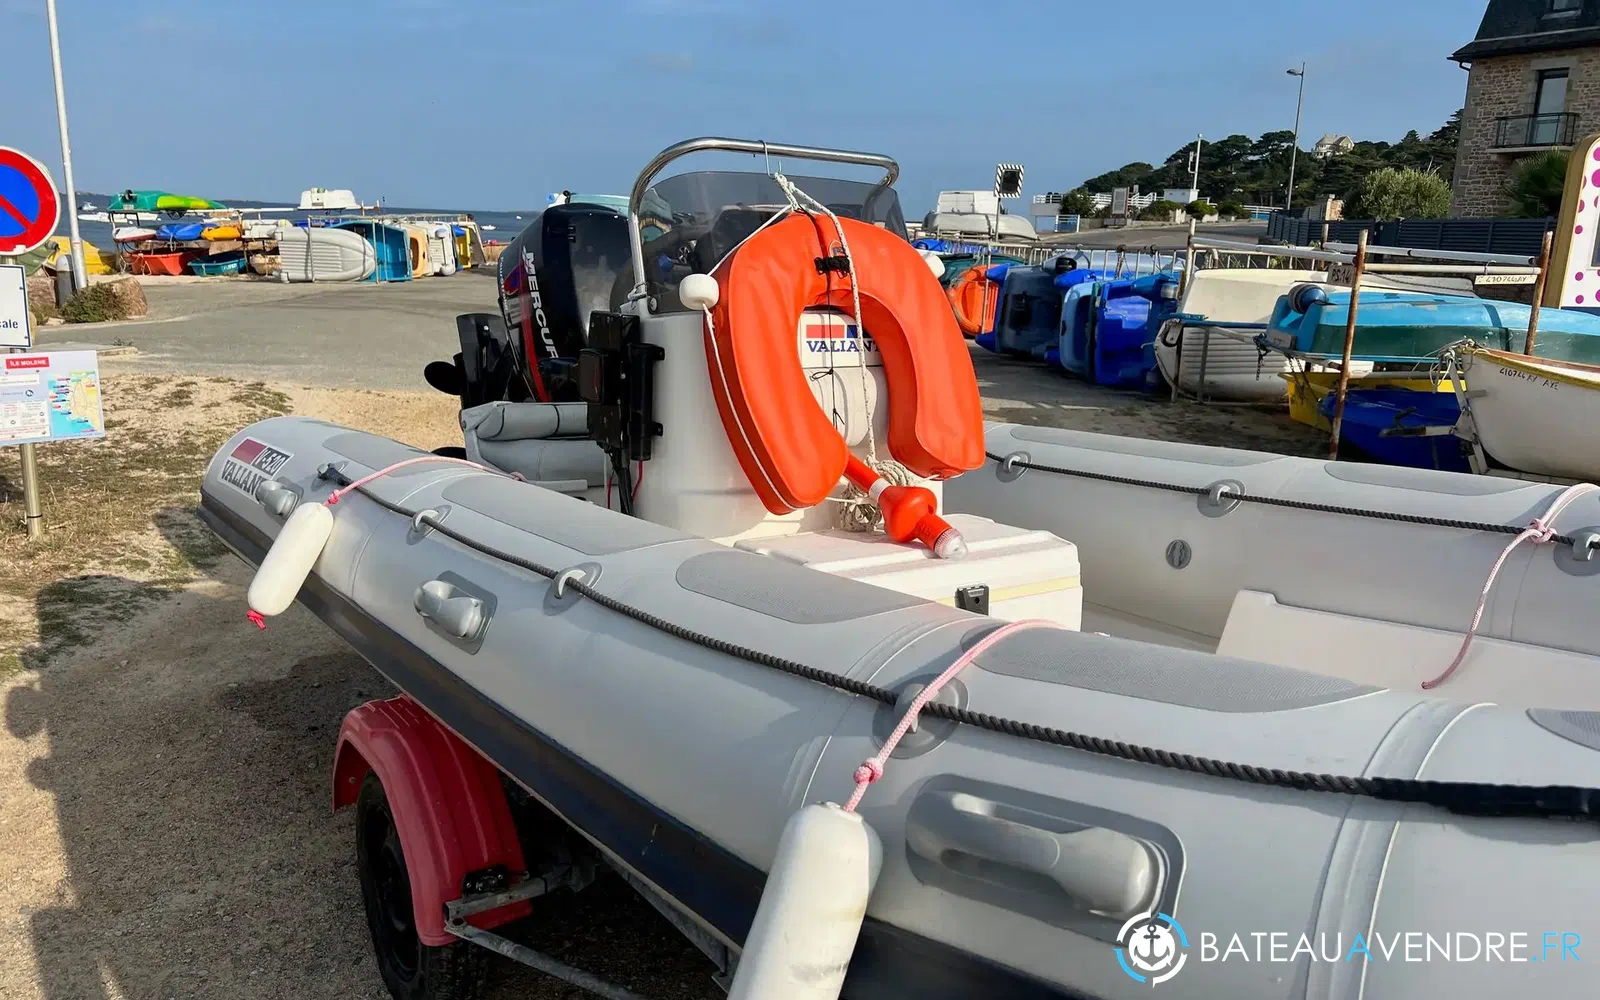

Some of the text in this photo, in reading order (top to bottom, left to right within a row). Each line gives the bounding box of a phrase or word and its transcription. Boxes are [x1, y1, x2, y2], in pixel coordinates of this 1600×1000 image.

[522, 246, 559, 359] MERCUR
[0, 319, 19, 329] ale
[221, 459, 268, 496] VALIAN
